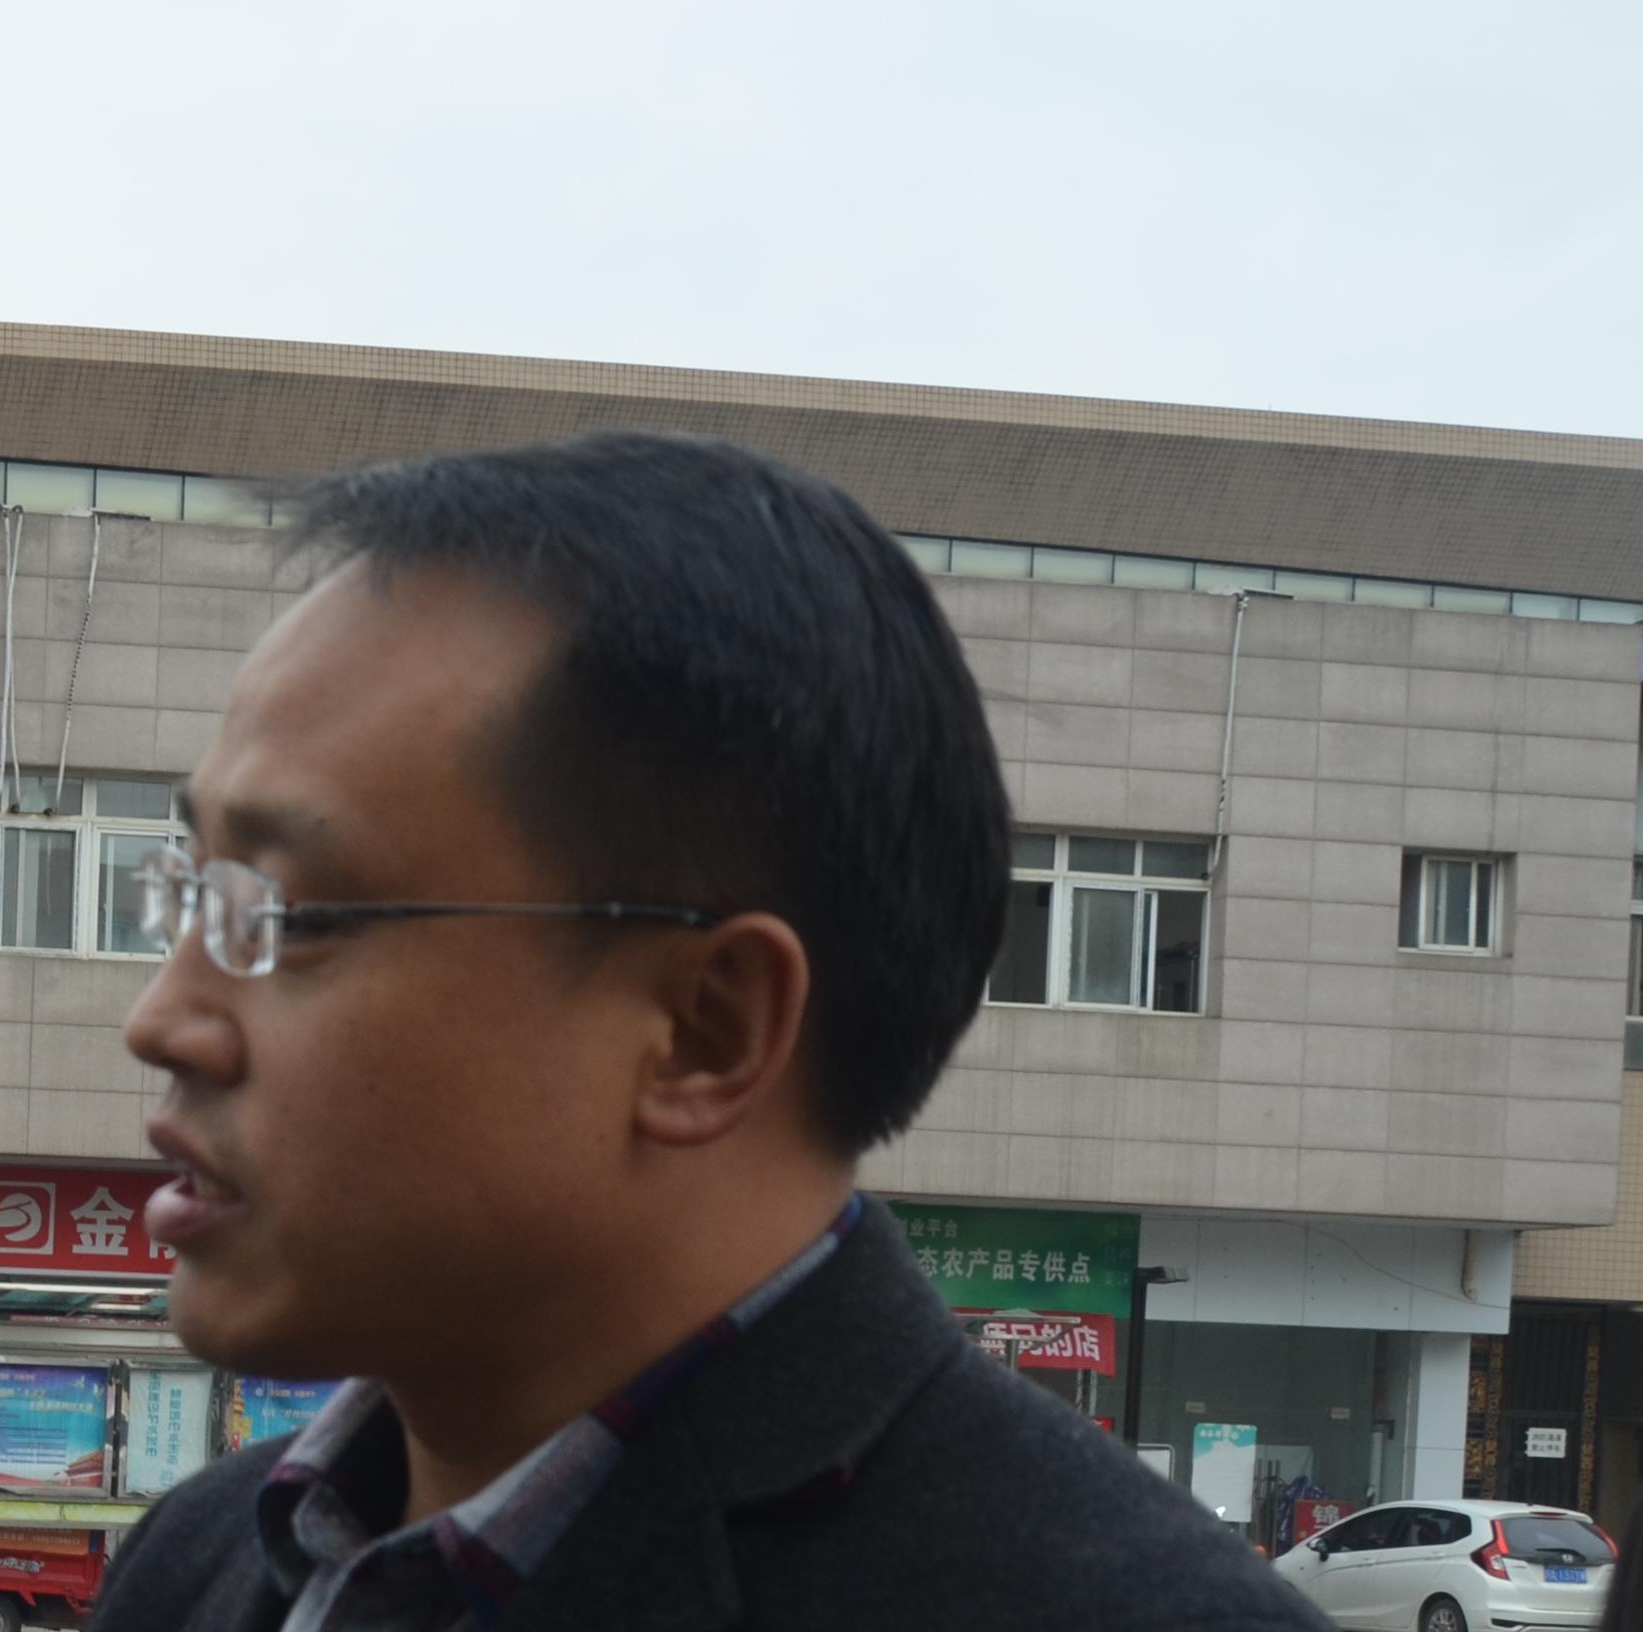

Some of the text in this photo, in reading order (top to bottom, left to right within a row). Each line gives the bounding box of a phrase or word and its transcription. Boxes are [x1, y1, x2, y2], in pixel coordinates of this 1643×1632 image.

[917, 1246, 1091, 1283] 态农产品专供点
